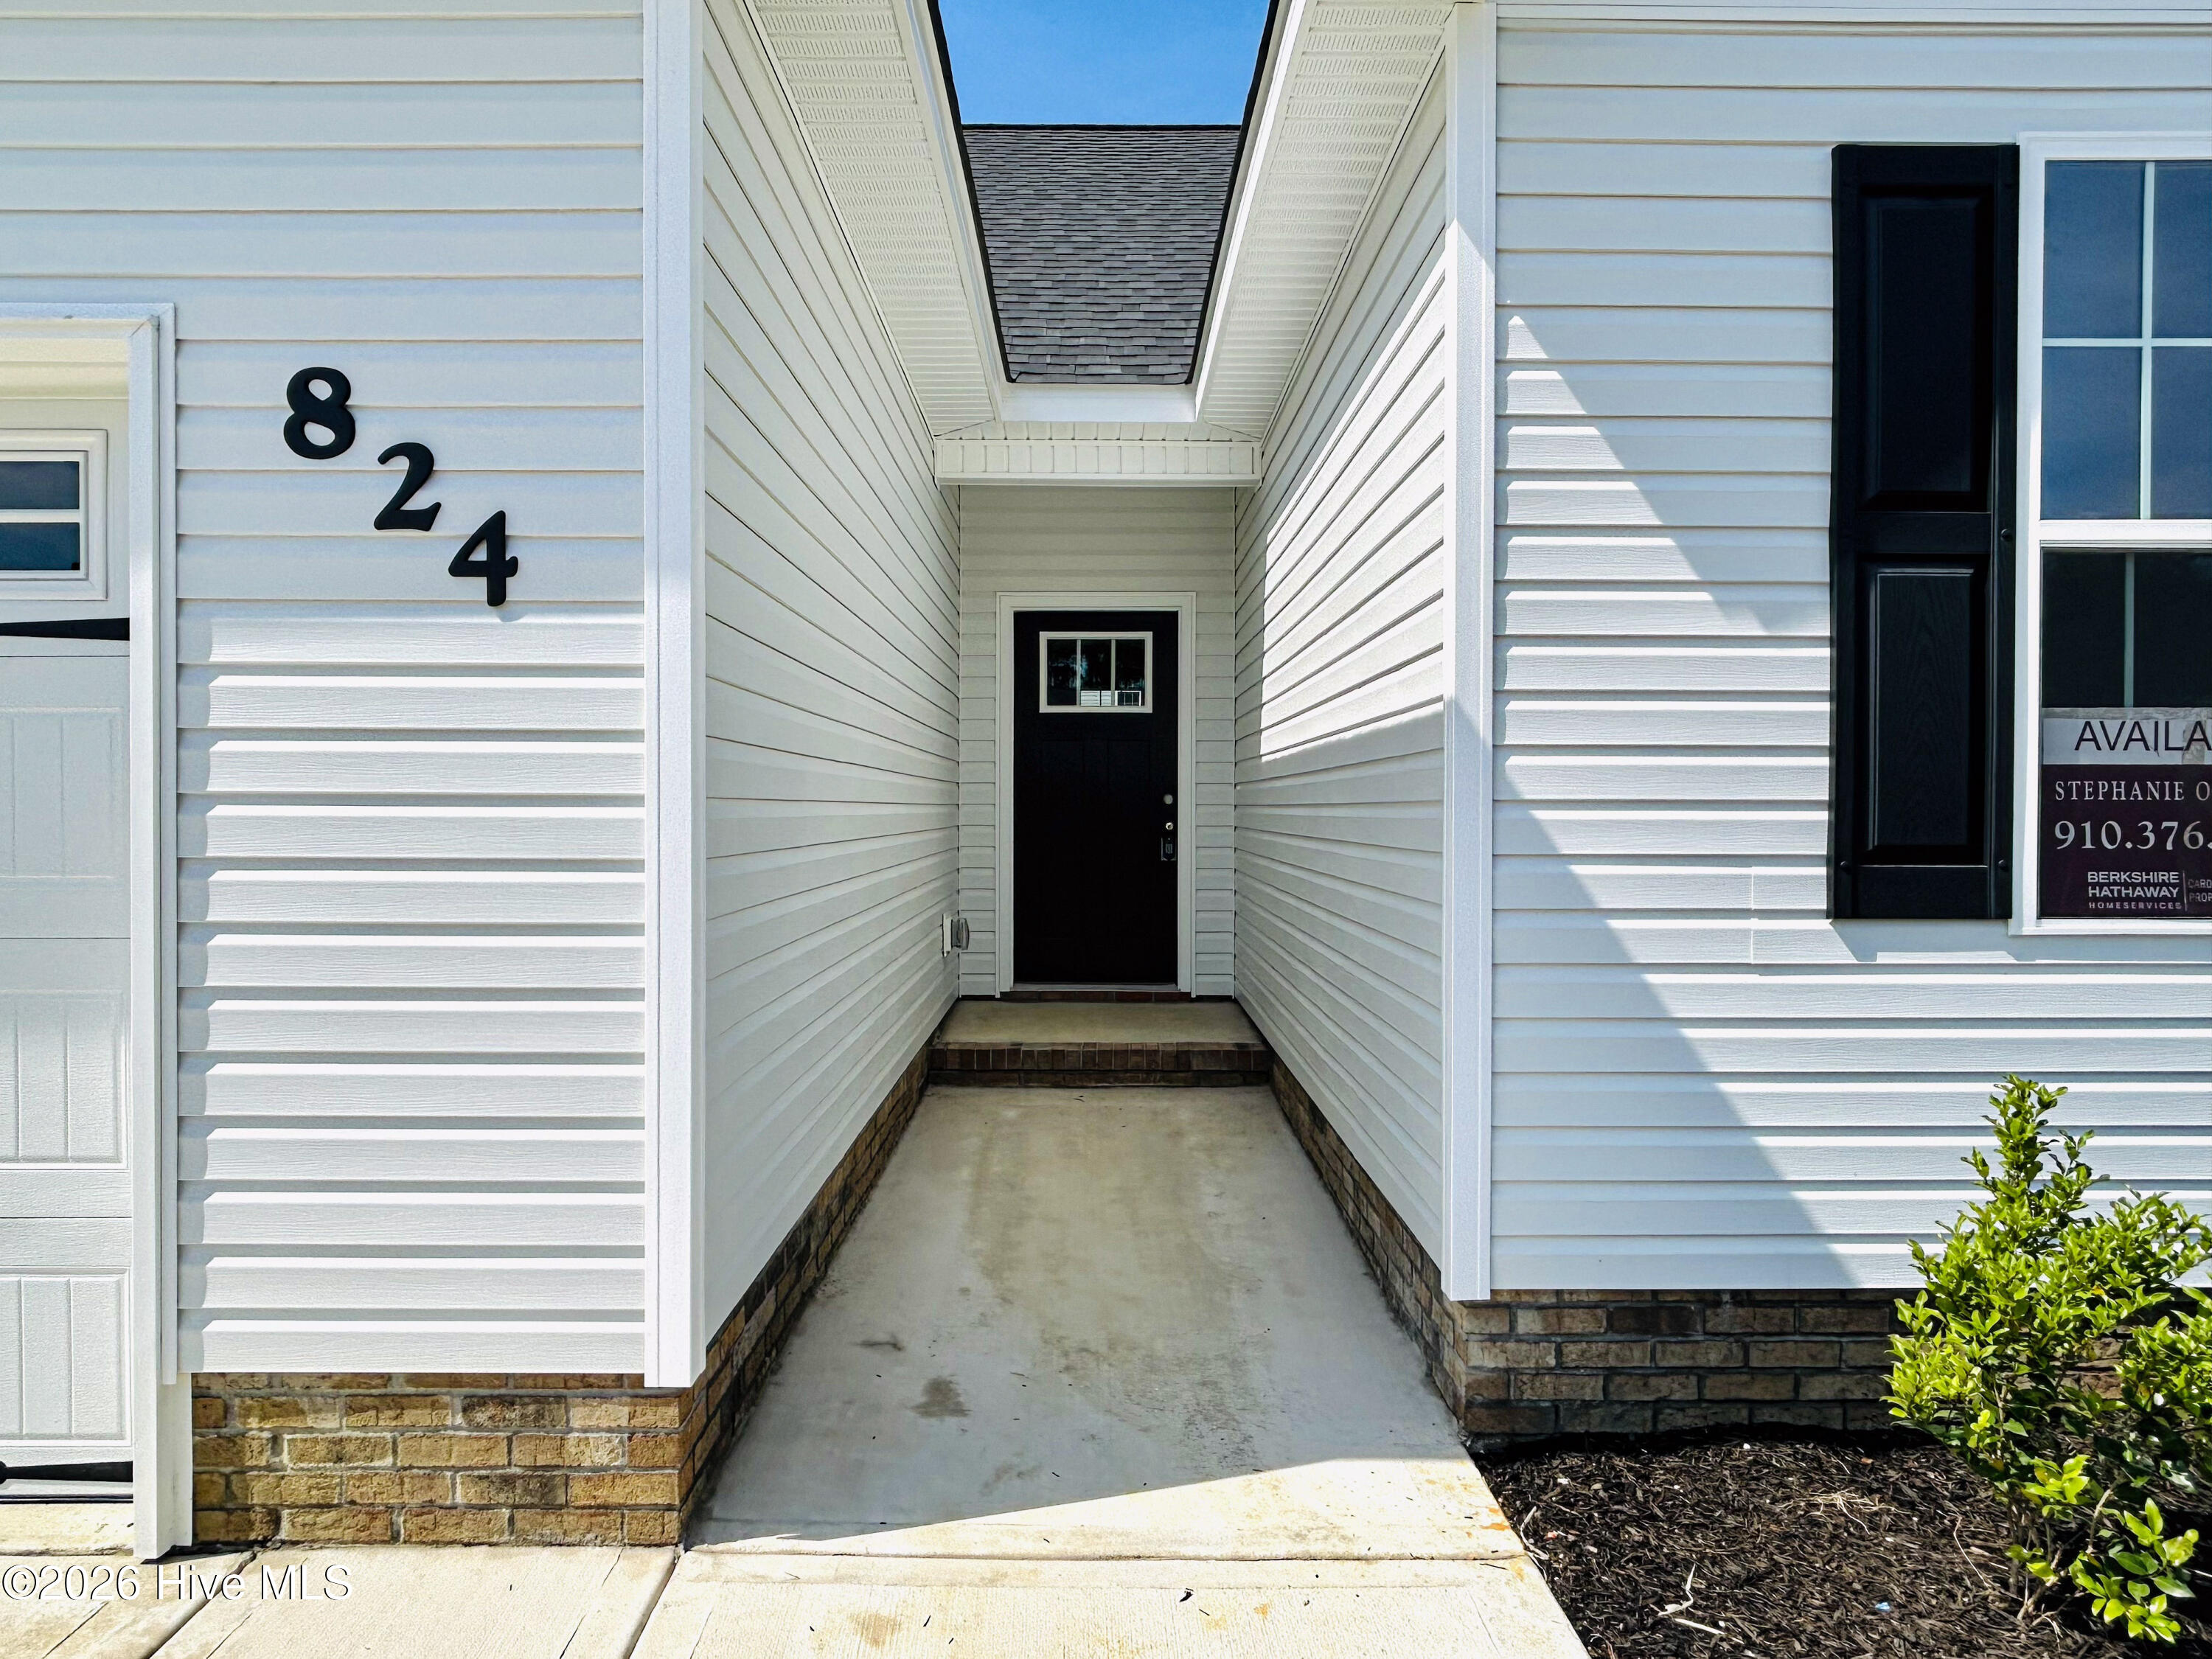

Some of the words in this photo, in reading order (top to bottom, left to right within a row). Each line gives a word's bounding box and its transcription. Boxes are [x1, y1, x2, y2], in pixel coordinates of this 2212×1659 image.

[283, 366, 518, 607] 824
[2074, 720, 2212, 751] AVAILA
[2055, 781, 2185, 801] STEPHANIE
[2087, 872, 2180, 883] BERKSHIRE
[2088, 886, 2180, 897] HATHAWAY
